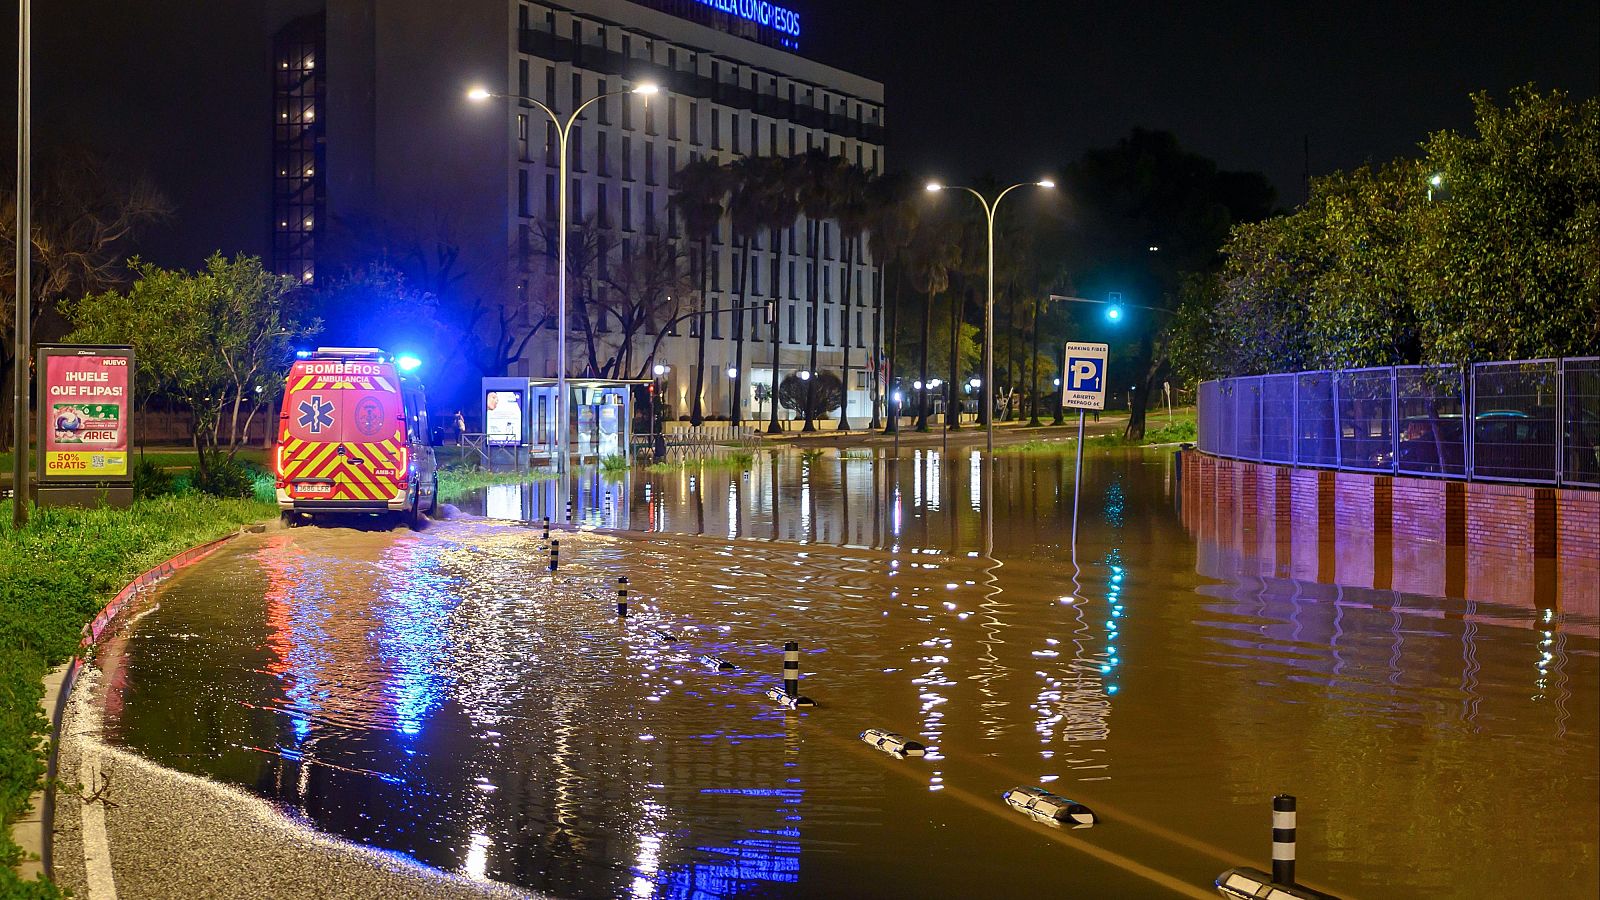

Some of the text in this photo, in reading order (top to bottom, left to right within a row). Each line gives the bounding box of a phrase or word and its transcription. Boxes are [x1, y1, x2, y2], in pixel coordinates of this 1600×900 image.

[740, 0, 800, 36] CONGRESOS
[305, 364, 381, 374] BOMBEROS
[1071, 360, 1097, 388] P
[66, 372, 108, 381] ¡HUELE
[51, 386, 122, 396] QUE FLIPAS!
